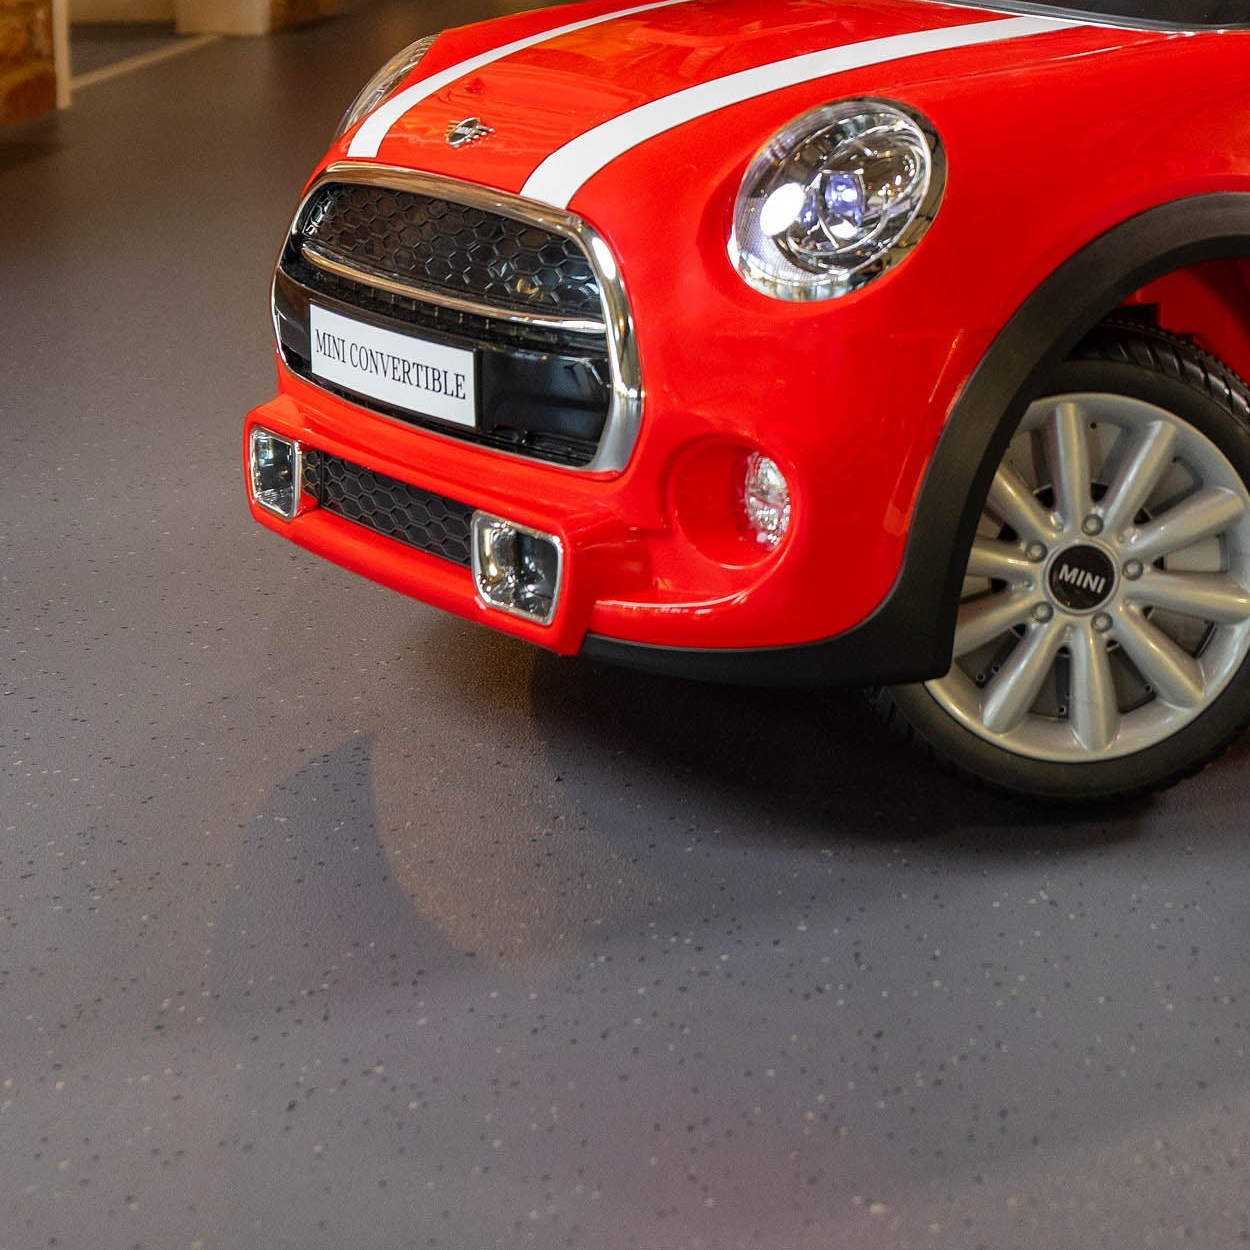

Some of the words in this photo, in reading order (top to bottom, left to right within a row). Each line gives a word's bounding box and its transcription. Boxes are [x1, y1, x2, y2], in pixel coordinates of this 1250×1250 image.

[316, 329, 346, 364] MINI
[350, 342, 467, 400] CONVERTIBLE
[1058, 562, 1107, 595] MINI
